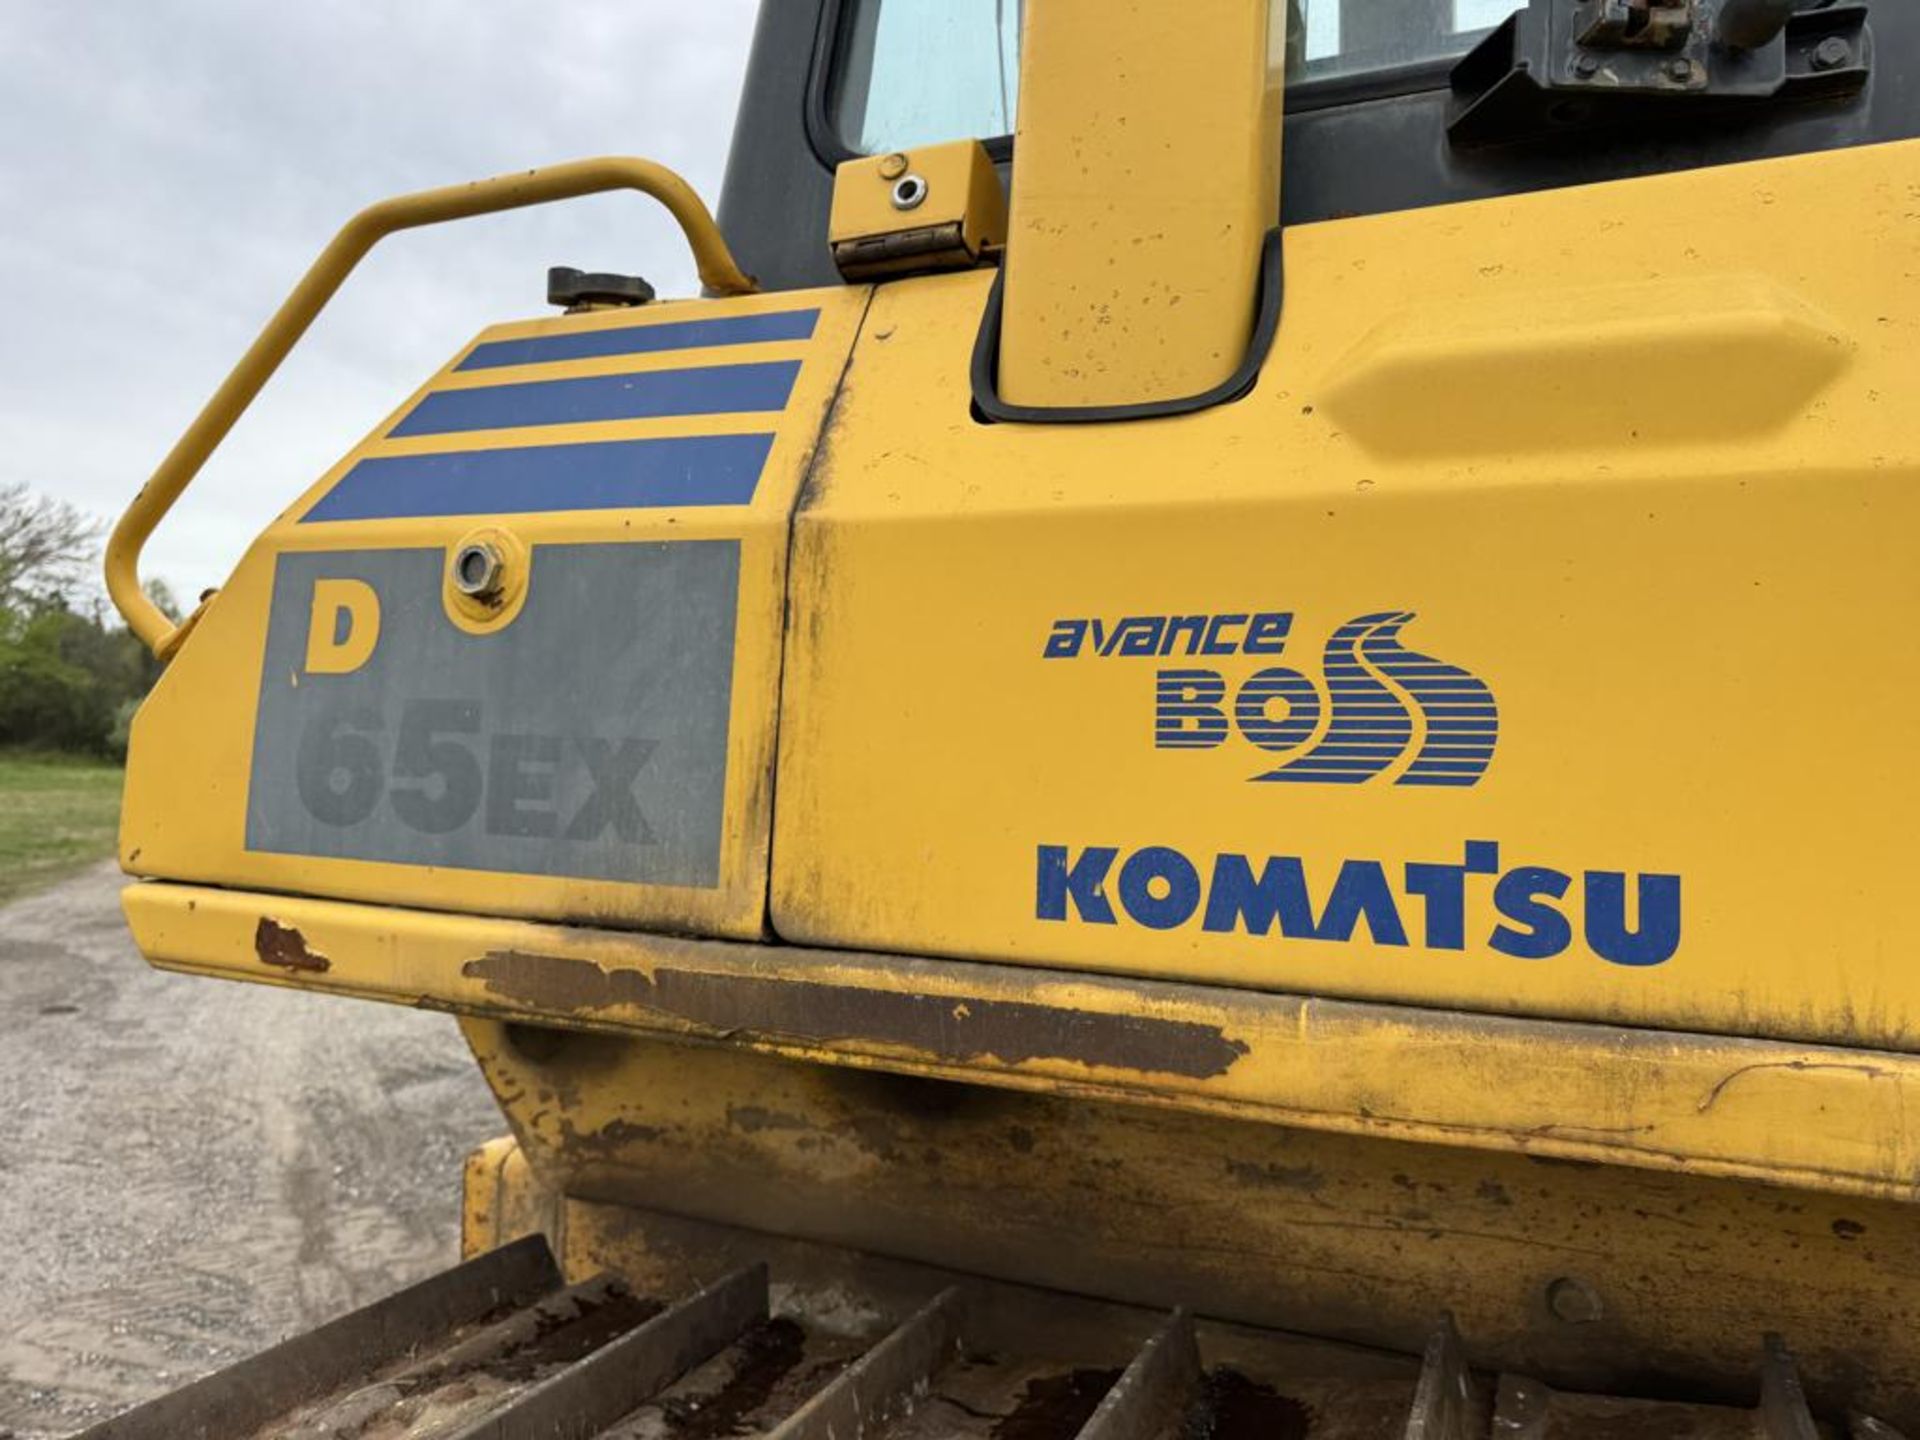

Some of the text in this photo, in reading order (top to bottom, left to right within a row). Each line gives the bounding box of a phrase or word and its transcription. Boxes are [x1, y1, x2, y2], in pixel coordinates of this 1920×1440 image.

[304, 578, 381, 674] D
[1043, 612, 1293, 659] avance
[296, 699, 661, 845] 65EX
[1036, 840, 1682, 967] KOMATSU
